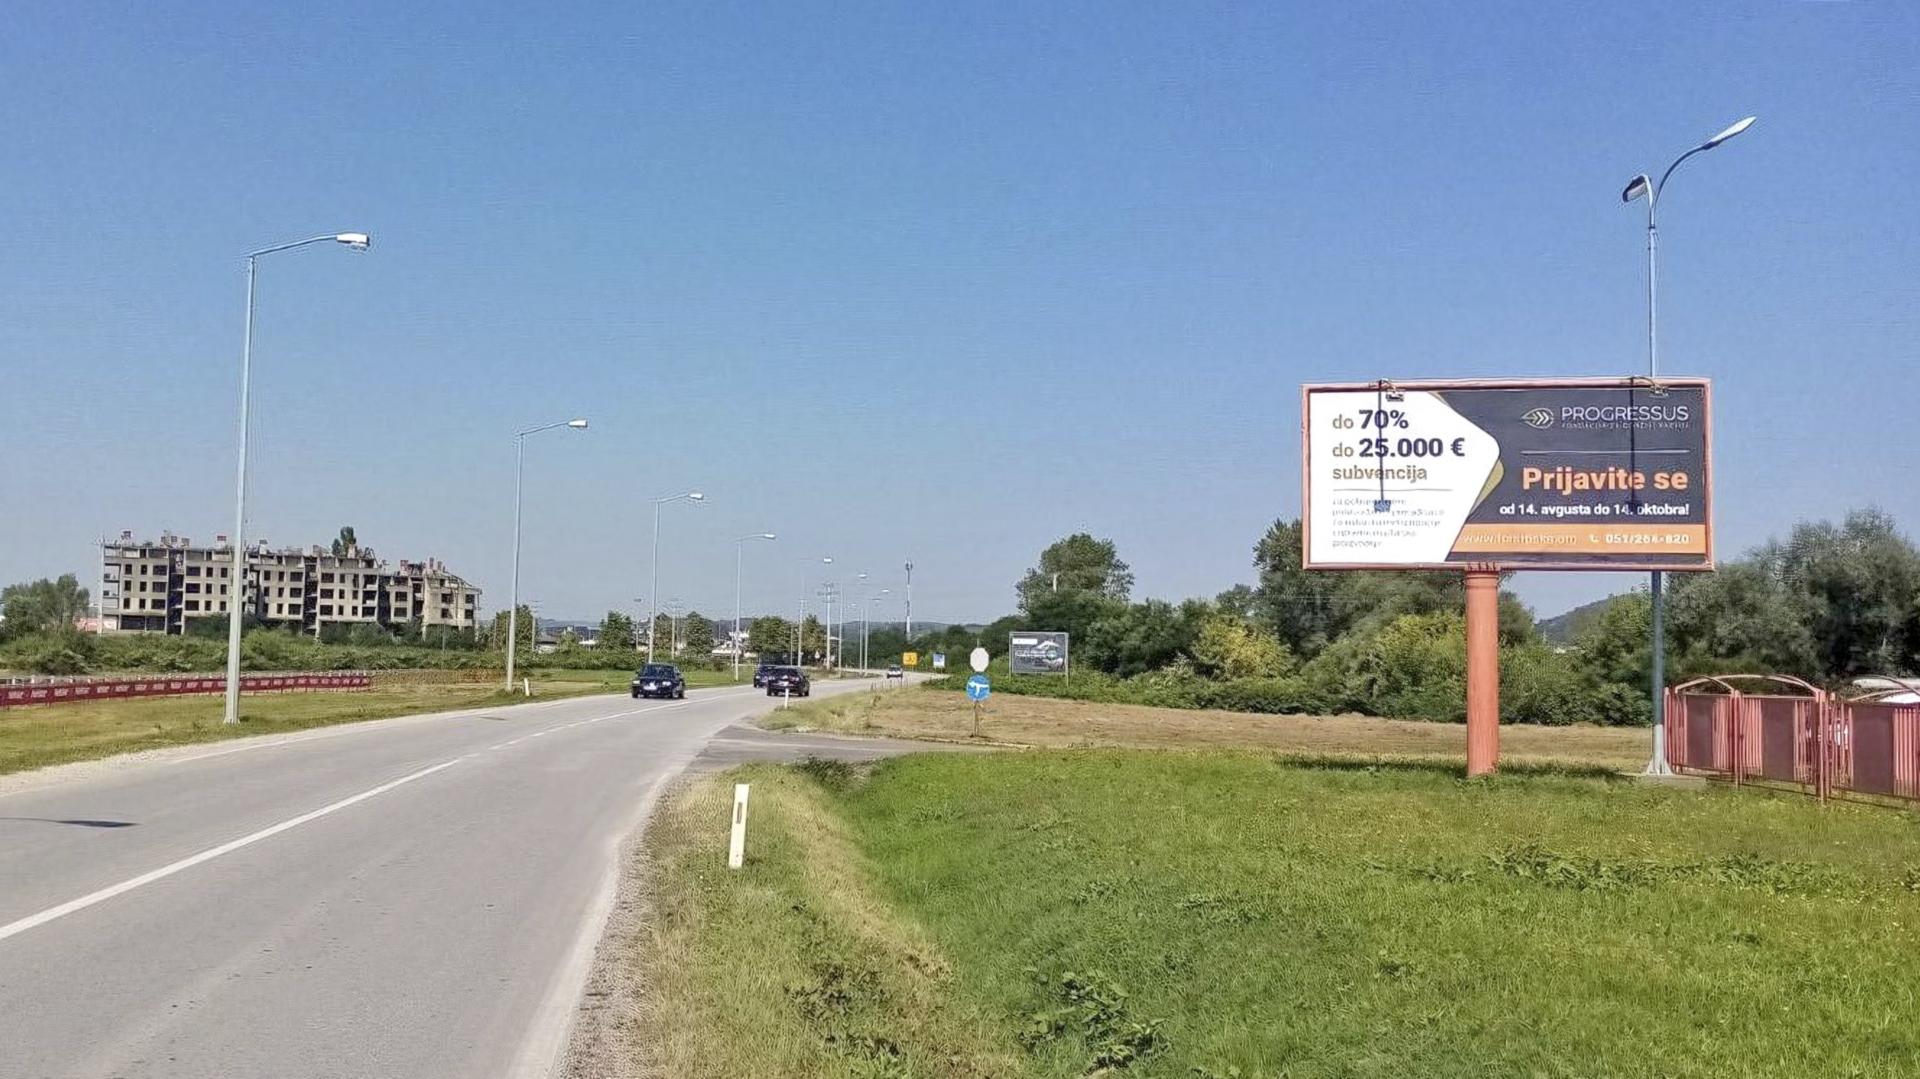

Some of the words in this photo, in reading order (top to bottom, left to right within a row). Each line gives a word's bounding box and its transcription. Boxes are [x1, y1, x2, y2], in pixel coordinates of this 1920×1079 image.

[1332, 413, 1354, 429] do
[1358, 409, 1409, 429] 70%
[1561, 406, 1689, 421] PROGRESSUS
[1332, 442, 1354, 457] do
[1358, 438, 1444, 457] 25.000
[1450, 437, 1465, 457] €
[1332, 465, 1428, 484] subvencija
[1522, 466, 1646, 496] Prijavite
[1653, 472, 1689, 490] se
[1499, 503, 1515, 515] od
[1518, 503, 1538, 515] 14.
[1541, 504, 1591, 518] avgusta
[1593, 503, 1610, 515] do
[1613, 503, 1634, 515] 14.
[1637, 502, 1690, 515] oktobra!
